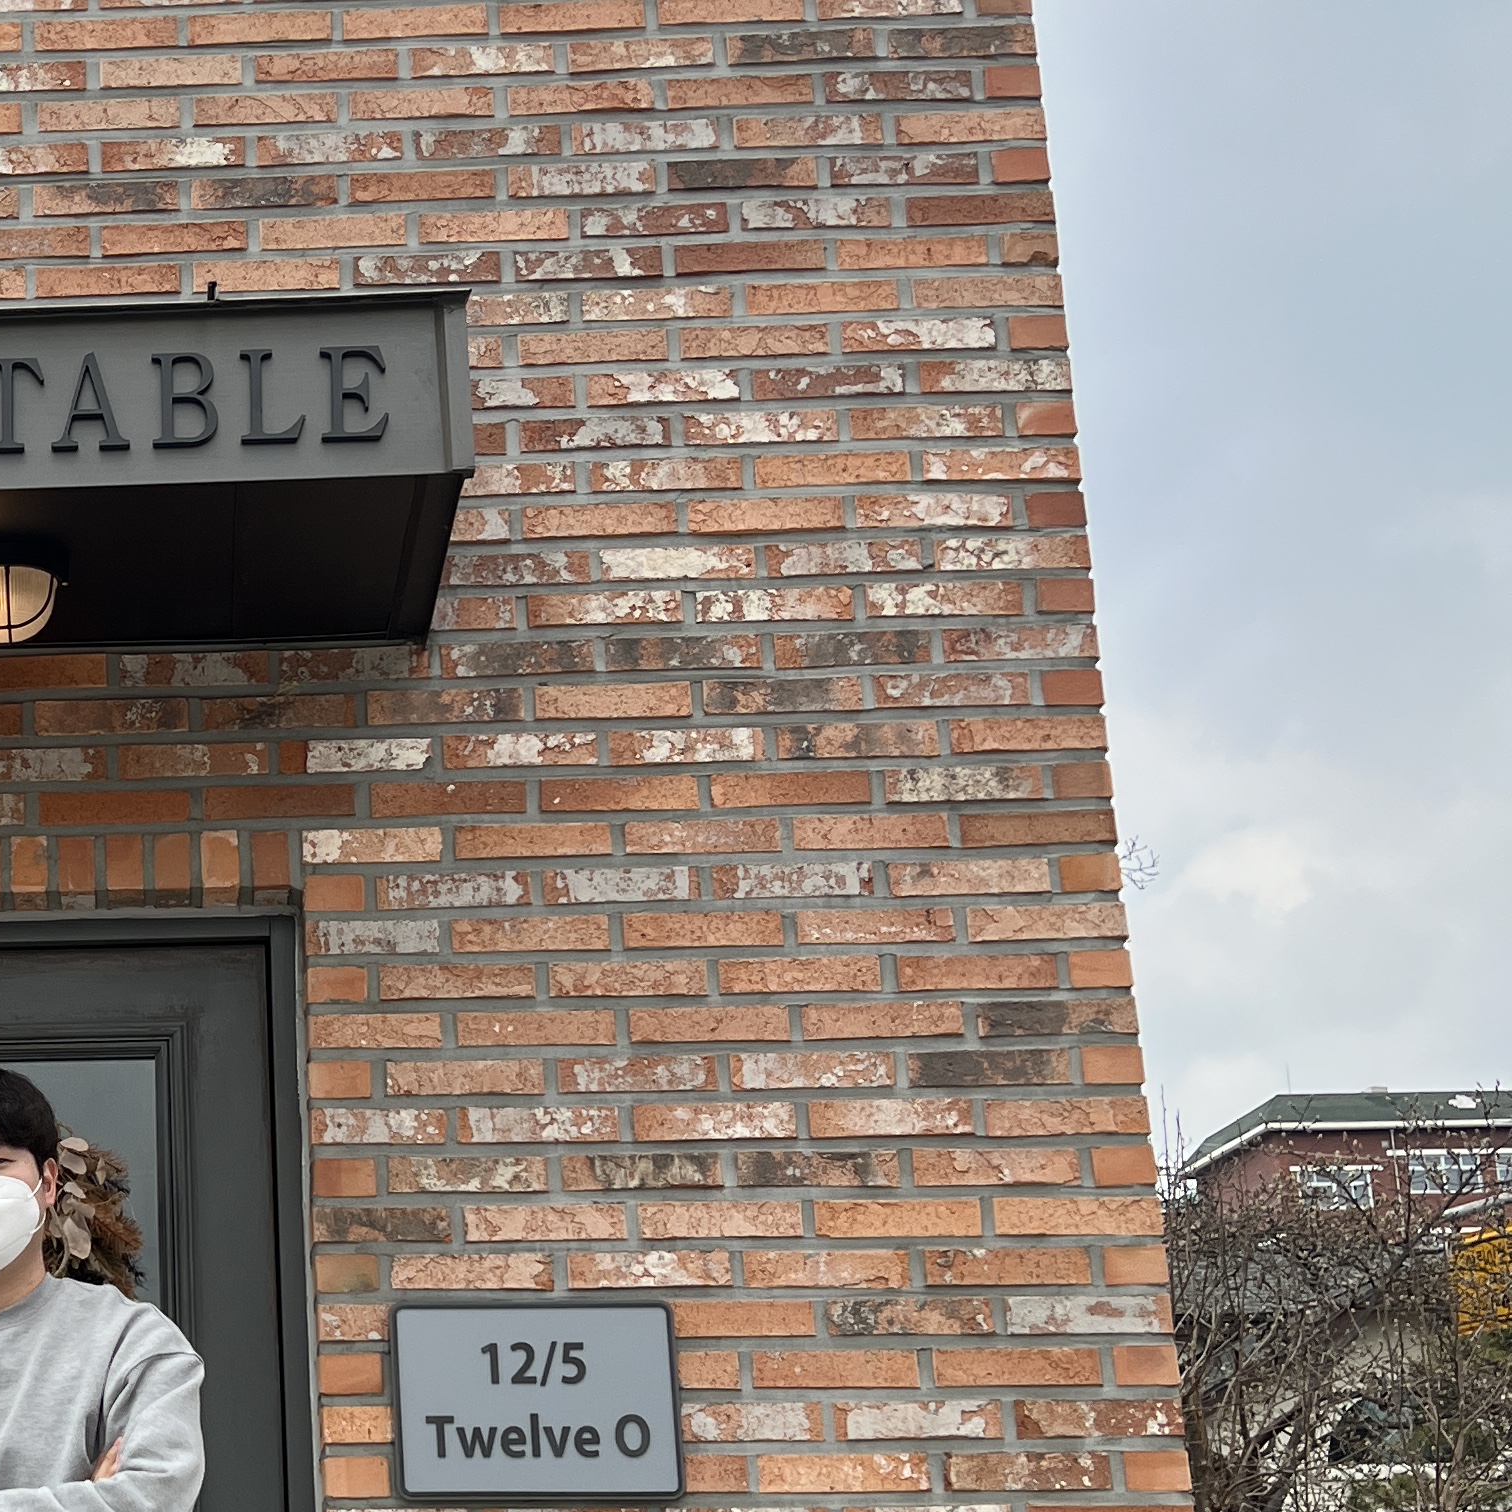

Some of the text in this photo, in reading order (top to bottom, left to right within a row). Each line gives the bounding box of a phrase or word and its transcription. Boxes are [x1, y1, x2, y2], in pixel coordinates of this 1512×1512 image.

[481, 1341, 587, 1386] 12/5
[425, 1413, 651, 1459] Twelve O
